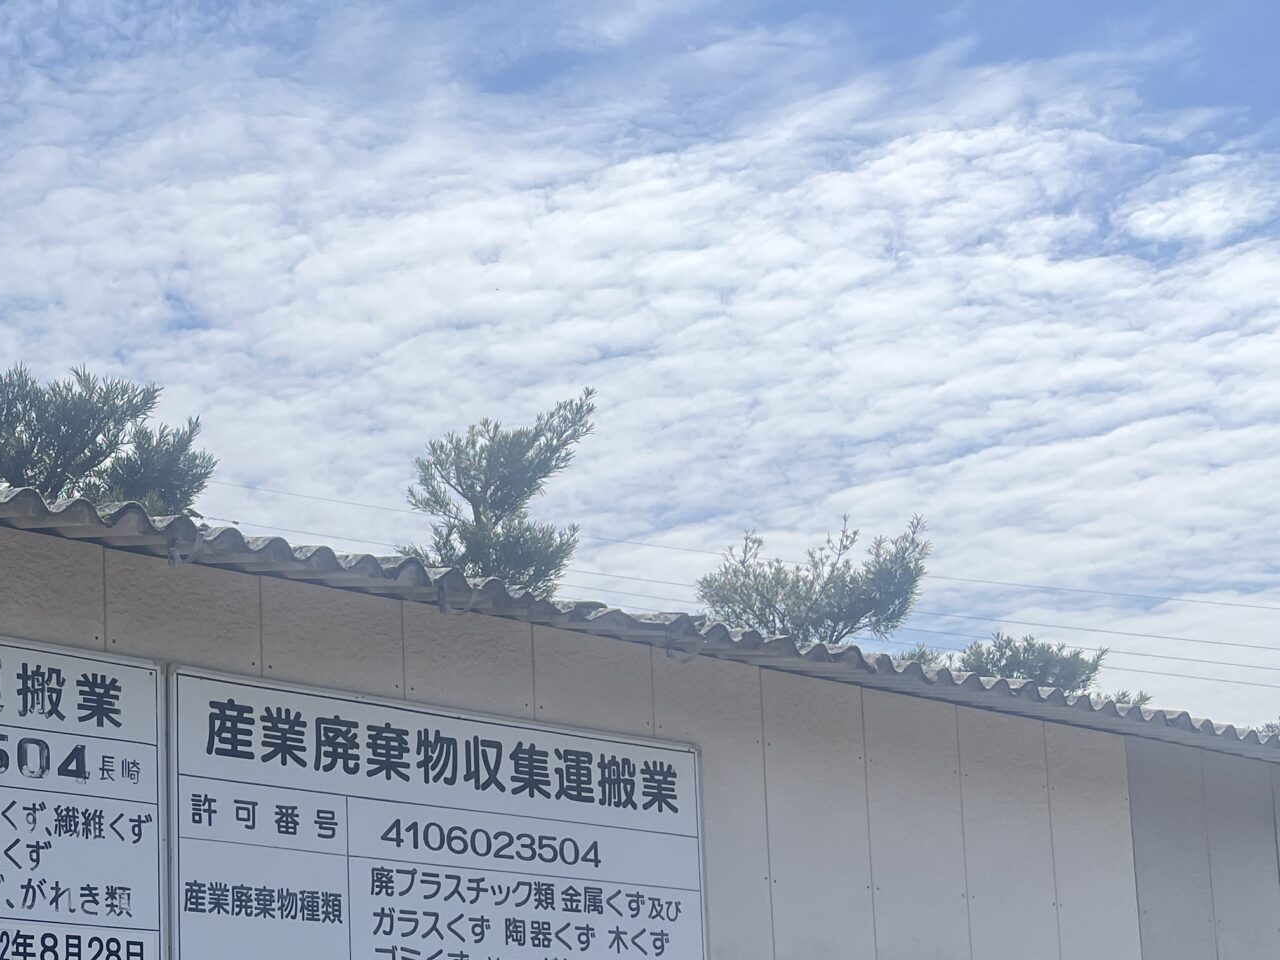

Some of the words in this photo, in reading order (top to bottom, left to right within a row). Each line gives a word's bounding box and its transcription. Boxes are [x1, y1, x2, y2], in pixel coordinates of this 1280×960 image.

[98, 754, 141, 785] 長崎
[206, 698, 679, 815] 産業廃棄物収集運搬業
[190, 793, 339, 840] 許可番号
[380, 818, 602, 869] 4106023504
[184, 881, 344, 925] 産業廃棄物種類
[372, 906, 492, 944] ガラスくず
[504, 916, 596, 952] 陶器くず
[608, 926, 671, 957] 木くず
